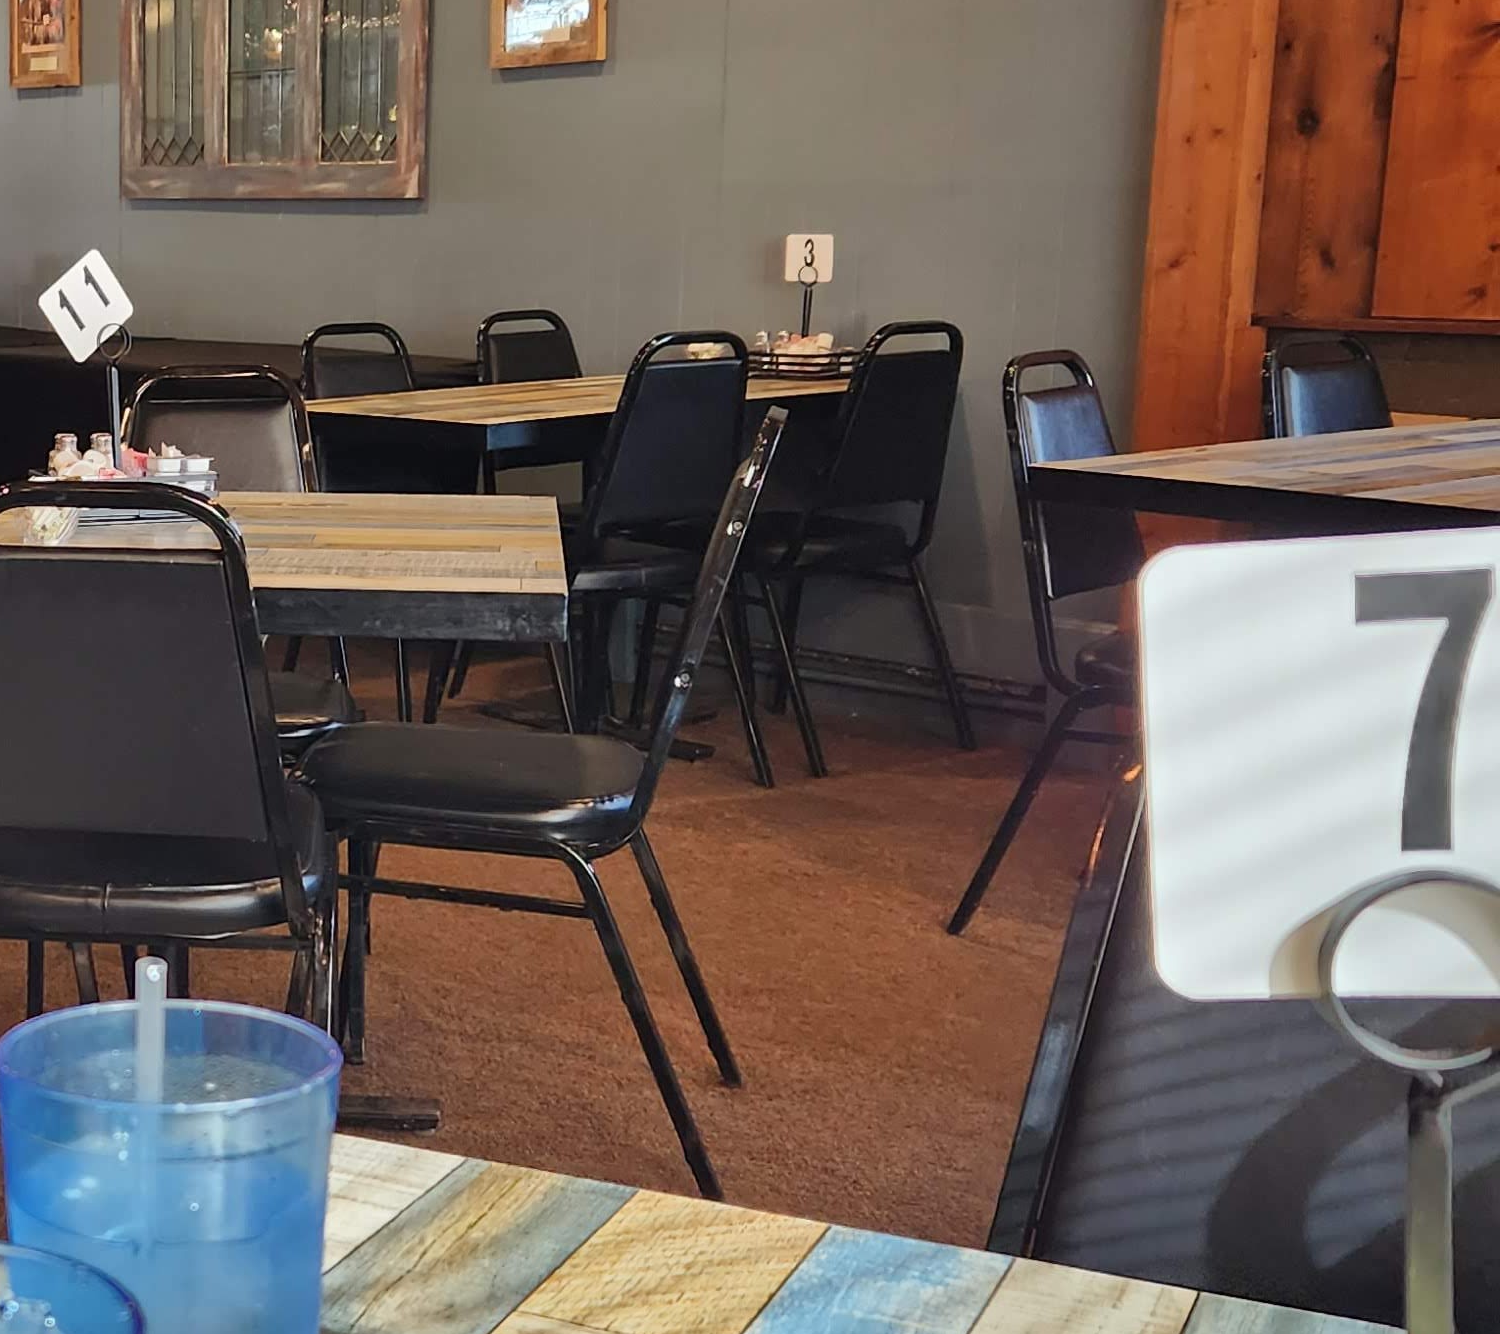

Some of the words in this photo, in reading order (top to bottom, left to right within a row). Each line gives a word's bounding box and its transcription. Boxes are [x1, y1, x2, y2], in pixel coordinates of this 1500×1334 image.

[804, 238, 816, 267] 3
[58, 264, 111, 332] 11
[1353, 567, 1494, 853] 7
